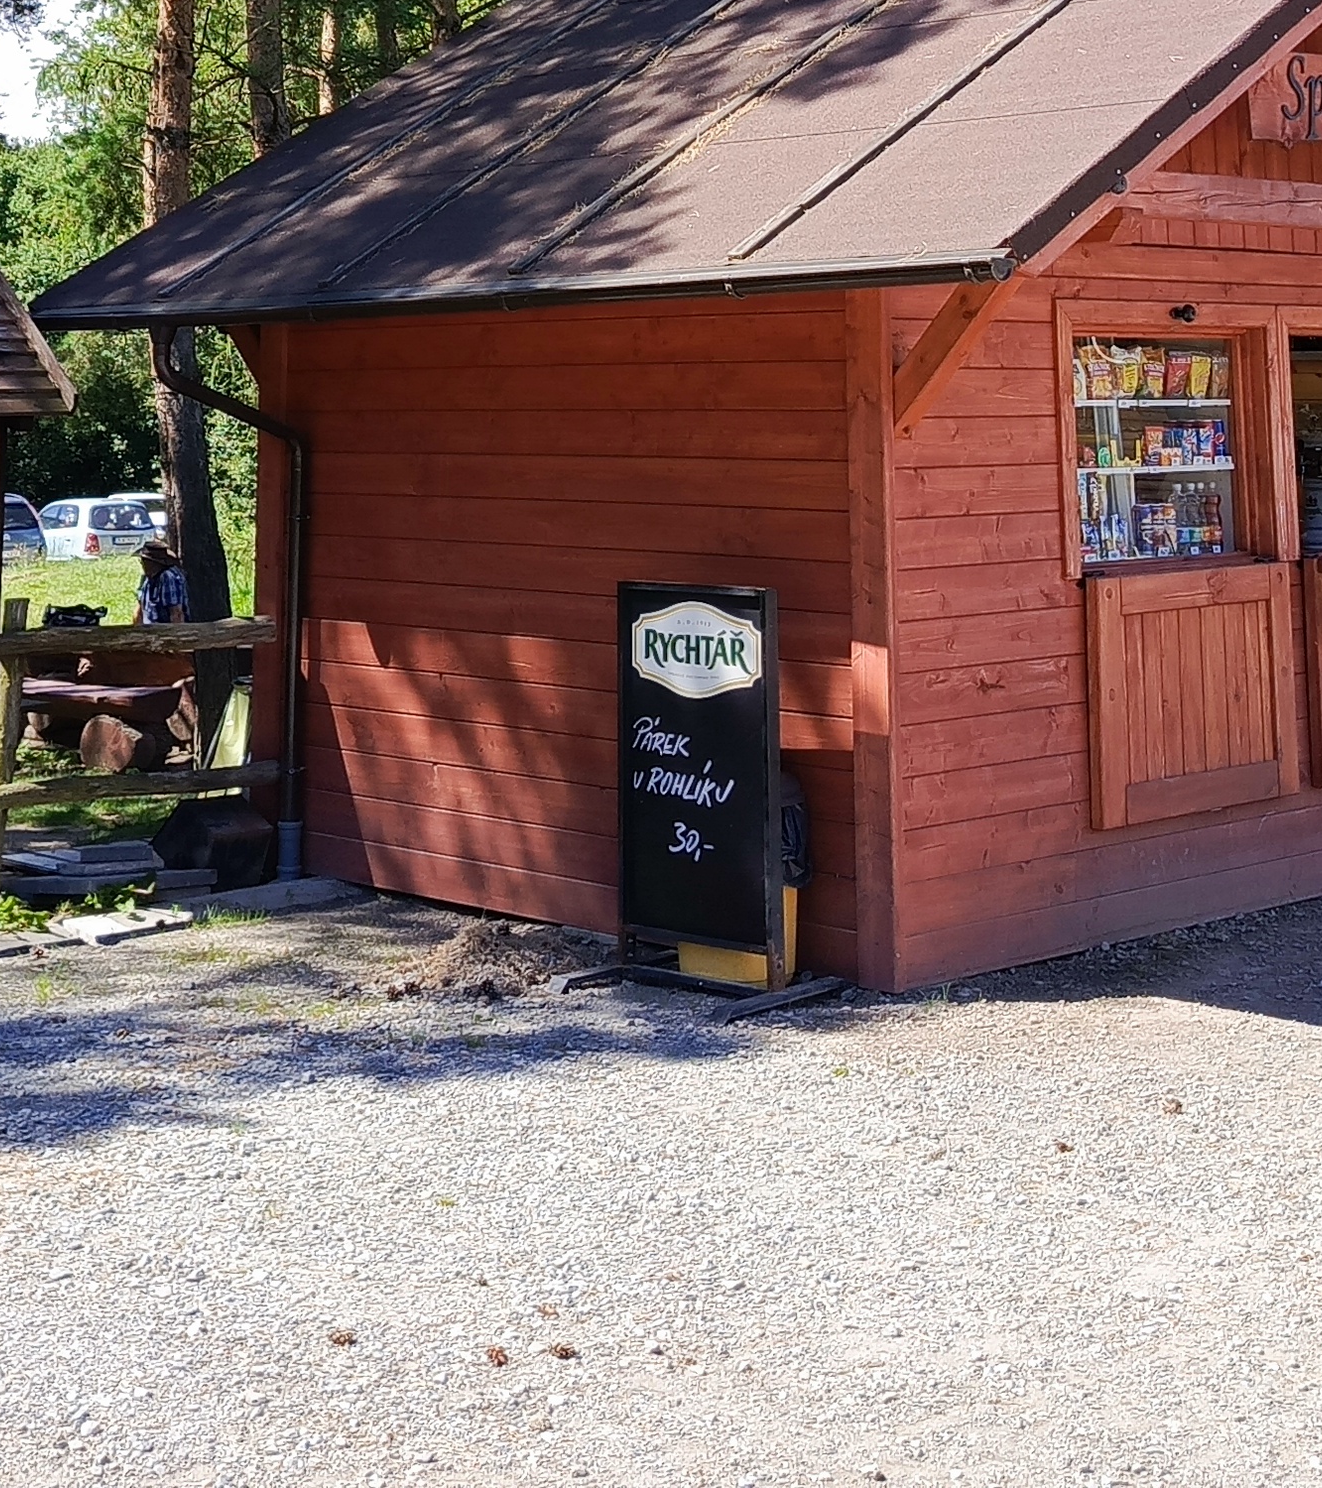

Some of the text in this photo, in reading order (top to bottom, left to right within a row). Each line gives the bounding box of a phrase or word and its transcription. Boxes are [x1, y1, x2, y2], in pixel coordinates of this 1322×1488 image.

[644, 629, 753, 675] RYCHTÁŘ
[632, 716, 690, 757] PÁREK
[646, 759, 734, 808] ROHLÍKU
[668, 821, 715, 862] 30,-
